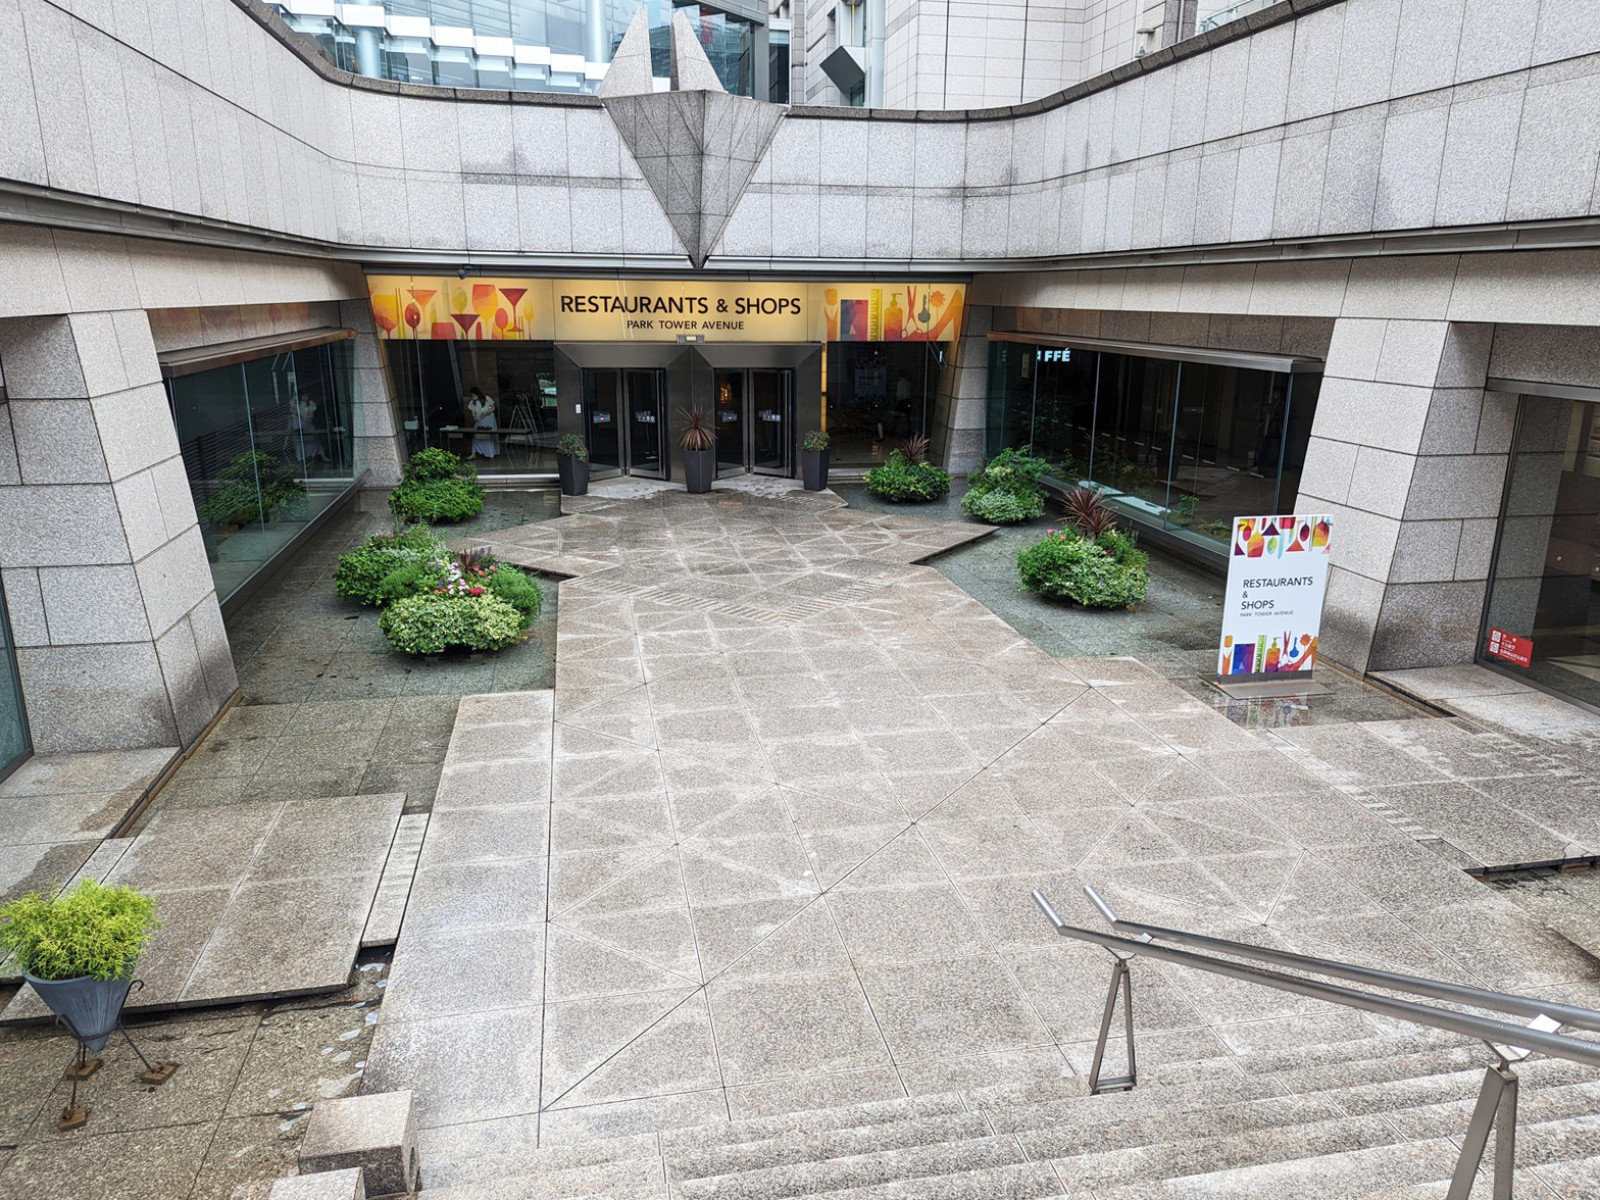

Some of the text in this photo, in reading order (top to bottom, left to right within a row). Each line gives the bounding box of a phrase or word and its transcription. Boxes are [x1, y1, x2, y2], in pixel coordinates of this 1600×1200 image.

[560, 295, 801, 315] RESTAURANTS & SHOPS
[626, 320, 745, 331] PARK TOWER AVENUE
[1243, 577, 1313, 588] RESTAURANTS
[1242, 590, 1248, 599] &
[1241, 600, 1275, 610] SHOPS
